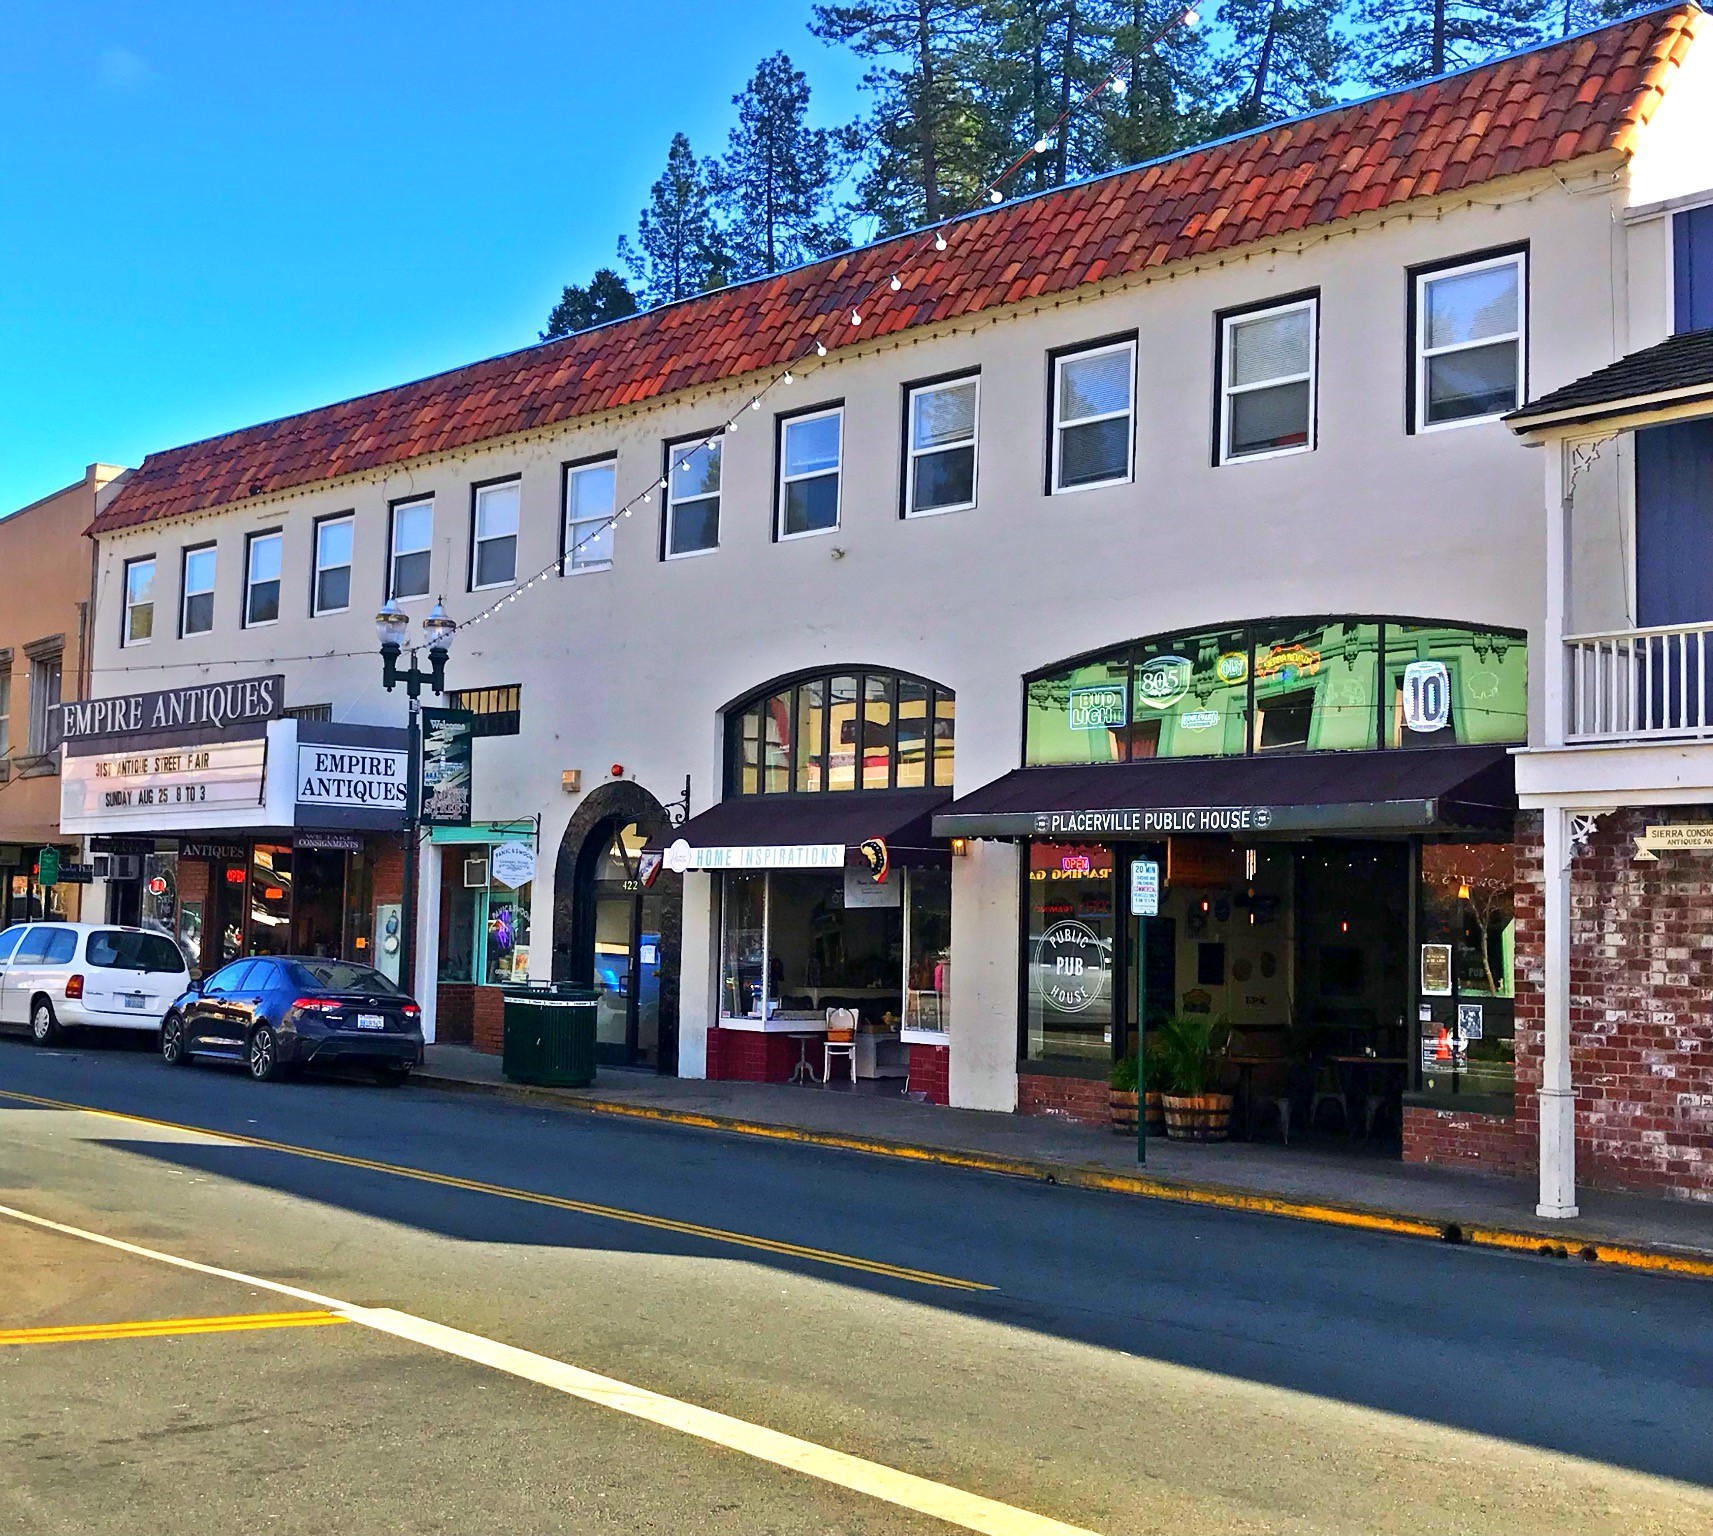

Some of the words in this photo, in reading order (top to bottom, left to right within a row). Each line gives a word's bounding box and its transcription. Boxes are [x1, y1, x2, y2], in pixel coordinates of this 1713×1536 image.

[1221, 659, 1243, 677] OLY
[1141, 667, 1179, 692] 805
[62, 697, 143, 737] EMPIRE
[151, 679, 274, 728] ANTIQUES
[1079, 691, 1116, 708] BUD
[1410, 676, 1441, 722] 10
[430, 719, 466, 731] Welcome
[1072, 708, 1122, 725] LIGHT
[96, 760, 111, 778] 31ST
[117, 757, 148, 776] ANTIQUE
[154, 755, 181, 772] STREET
[315, 752, 396, 777] EMPIRE
[105, 789, 133, 808] SUNDAY
[138, 789, 154, 805] AUG
[158, 787, 168, 803] 25
[176, 786, 182, 801] 8
[185, 785, 196, 801] TO
[200, 785, 206, 801] 3
[301, 777, 407, 803] ANTIQUES
[1051, 813, 1141, 832] PLACERVILLE
[1144, 811, 1196, 830] PUBLIC
[1200, 810, 1251, 829] HOUSE
[298, 838, 359, 849] CONSIGNMENTS
[1651, 829, 1684, 839] SIERRA
[1667, 838, 1702, 846] ANTIQUES
[183, 843, 245, 858] ANTIQUES
[697, 849, 732, 867] HOME
[740, 846, 838, 866] INSPIRATIONS
[1064, 858, 1088, 870] OPEN
[1135, 865, 1144, 874] 20
[1049, 928, 1089, 949] PUBLIC
[1056, 956, 1084, 975] PUB
[1050, 984, 1089, 1004] HOUSE
